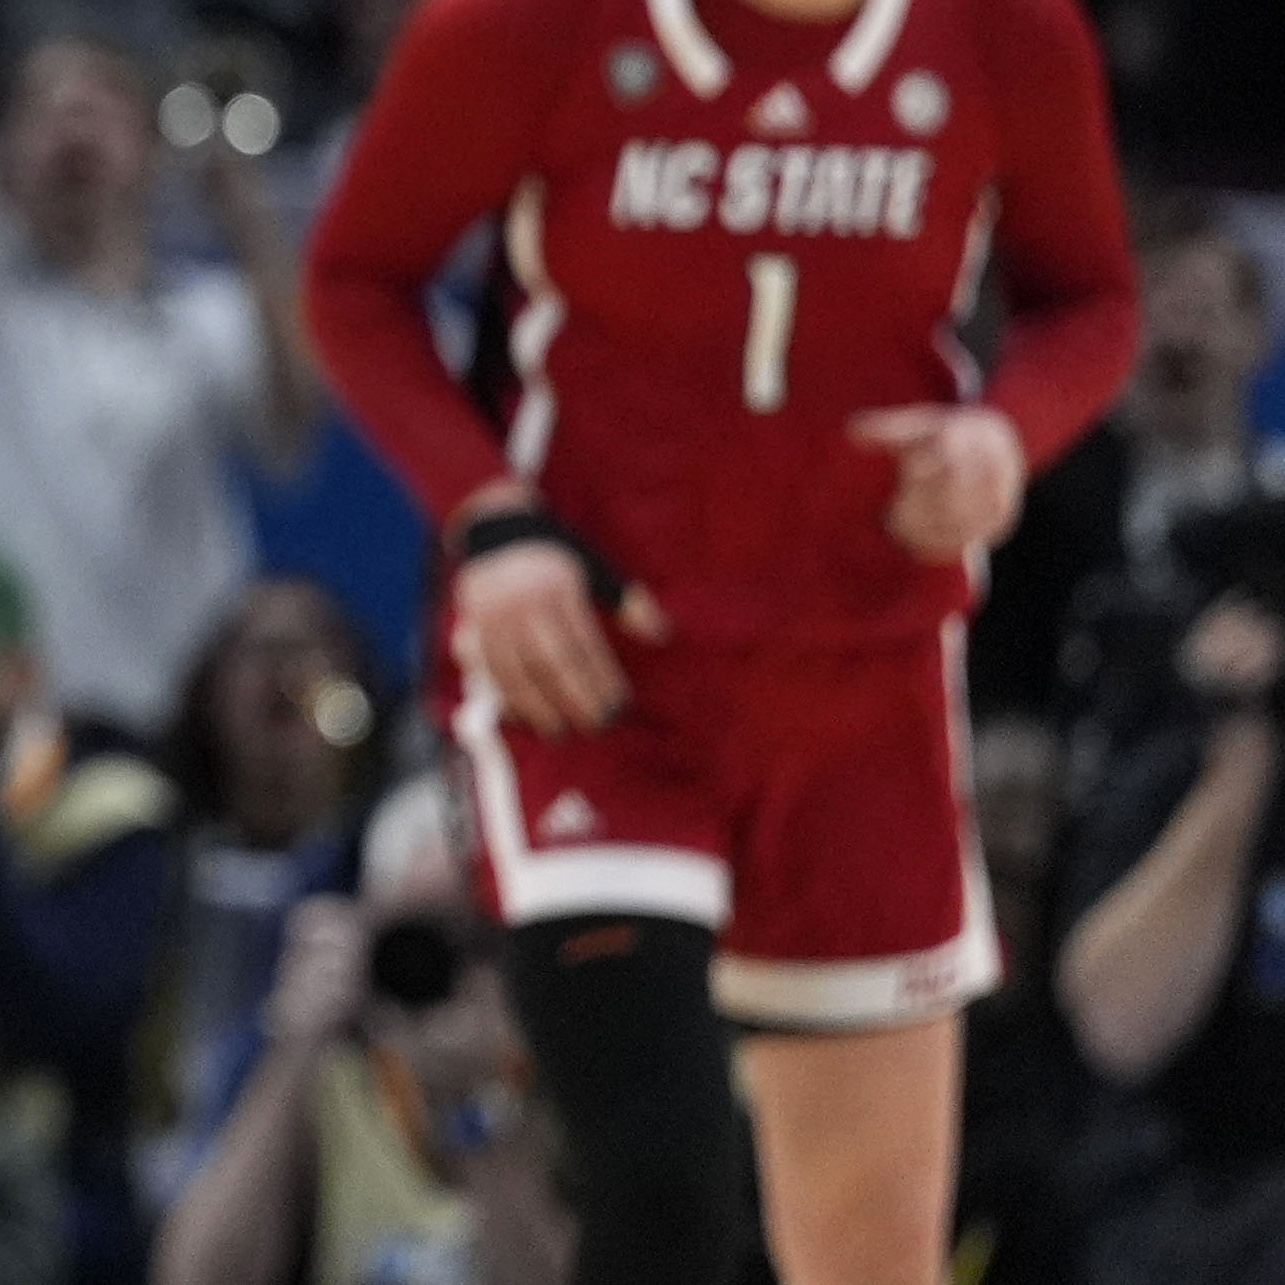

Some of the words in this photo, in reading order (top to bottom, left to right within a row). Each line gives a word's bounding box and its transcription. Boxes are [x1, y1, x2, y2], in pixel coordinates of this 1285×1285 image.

[609, 138, 720, 231] NC
[720, 142, 931, 239] STATE
[745, 253, 797, 412] 1
